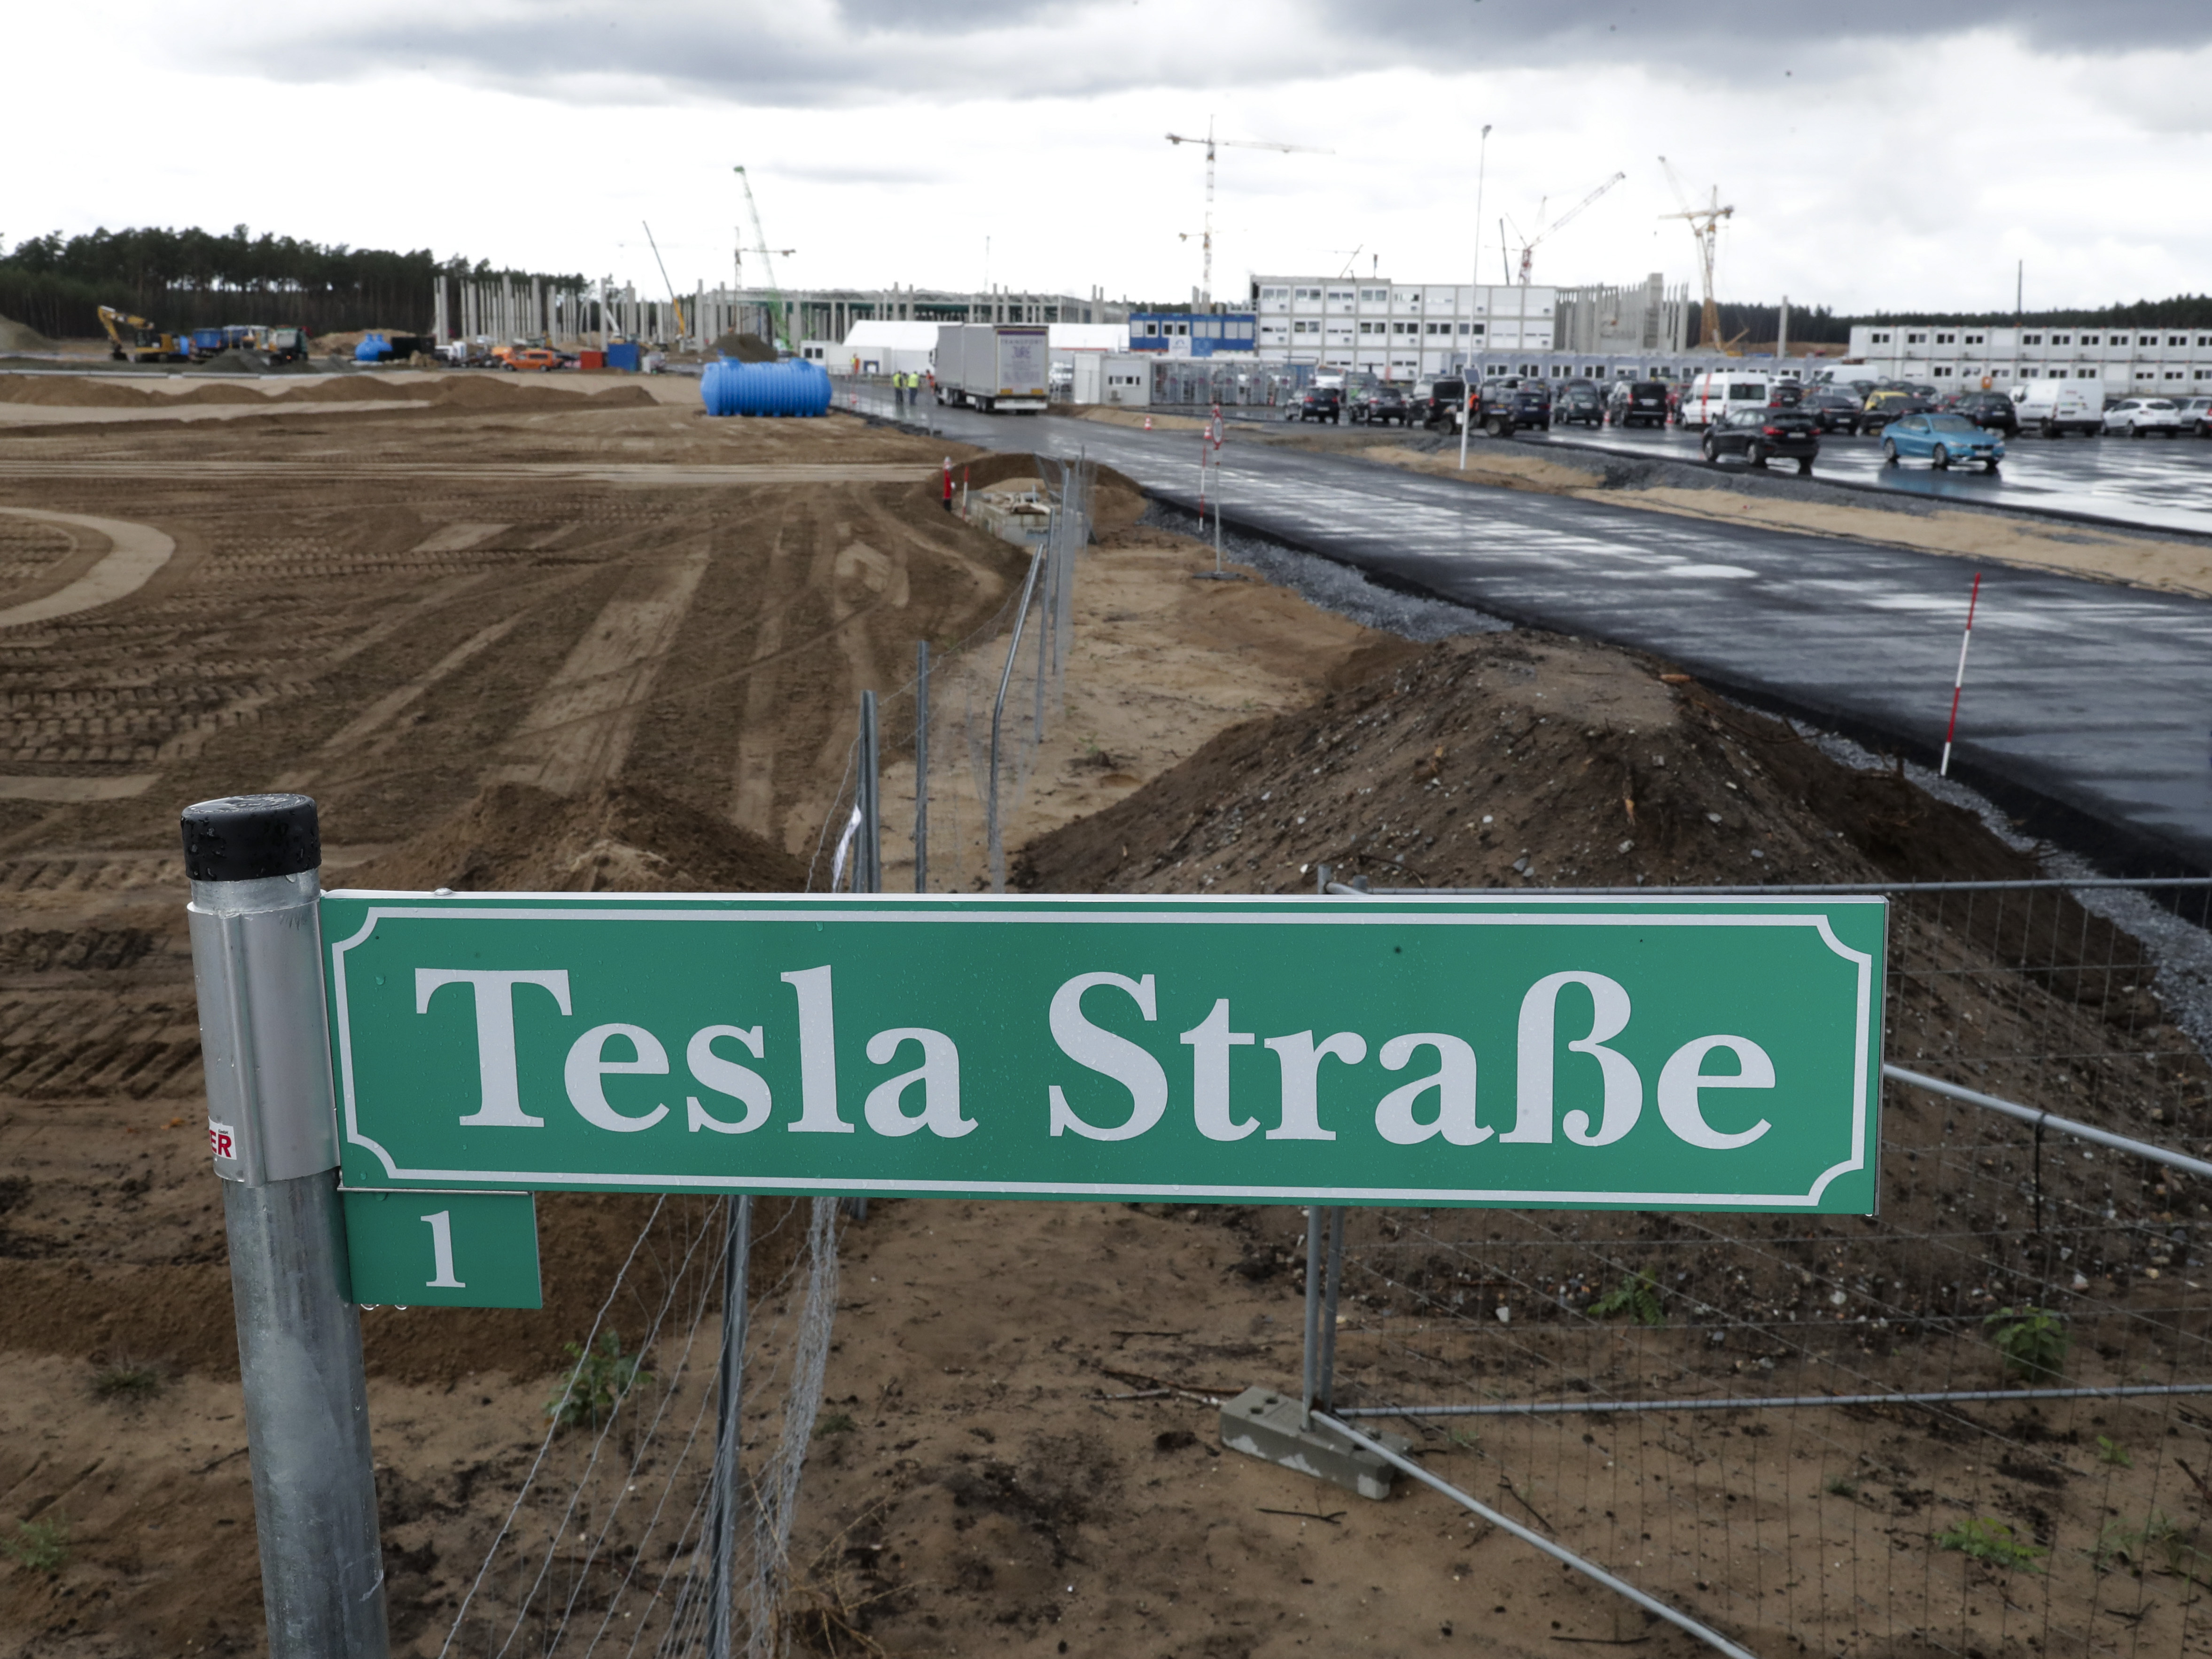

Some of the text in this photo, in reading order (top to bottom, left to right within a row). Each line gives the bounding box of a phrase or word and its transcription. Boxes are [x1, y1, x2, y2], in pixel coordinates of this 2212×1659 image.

[415, 965, 1775, 1149] Tesla Straße
[421, 1211, 465, 1287] 1
